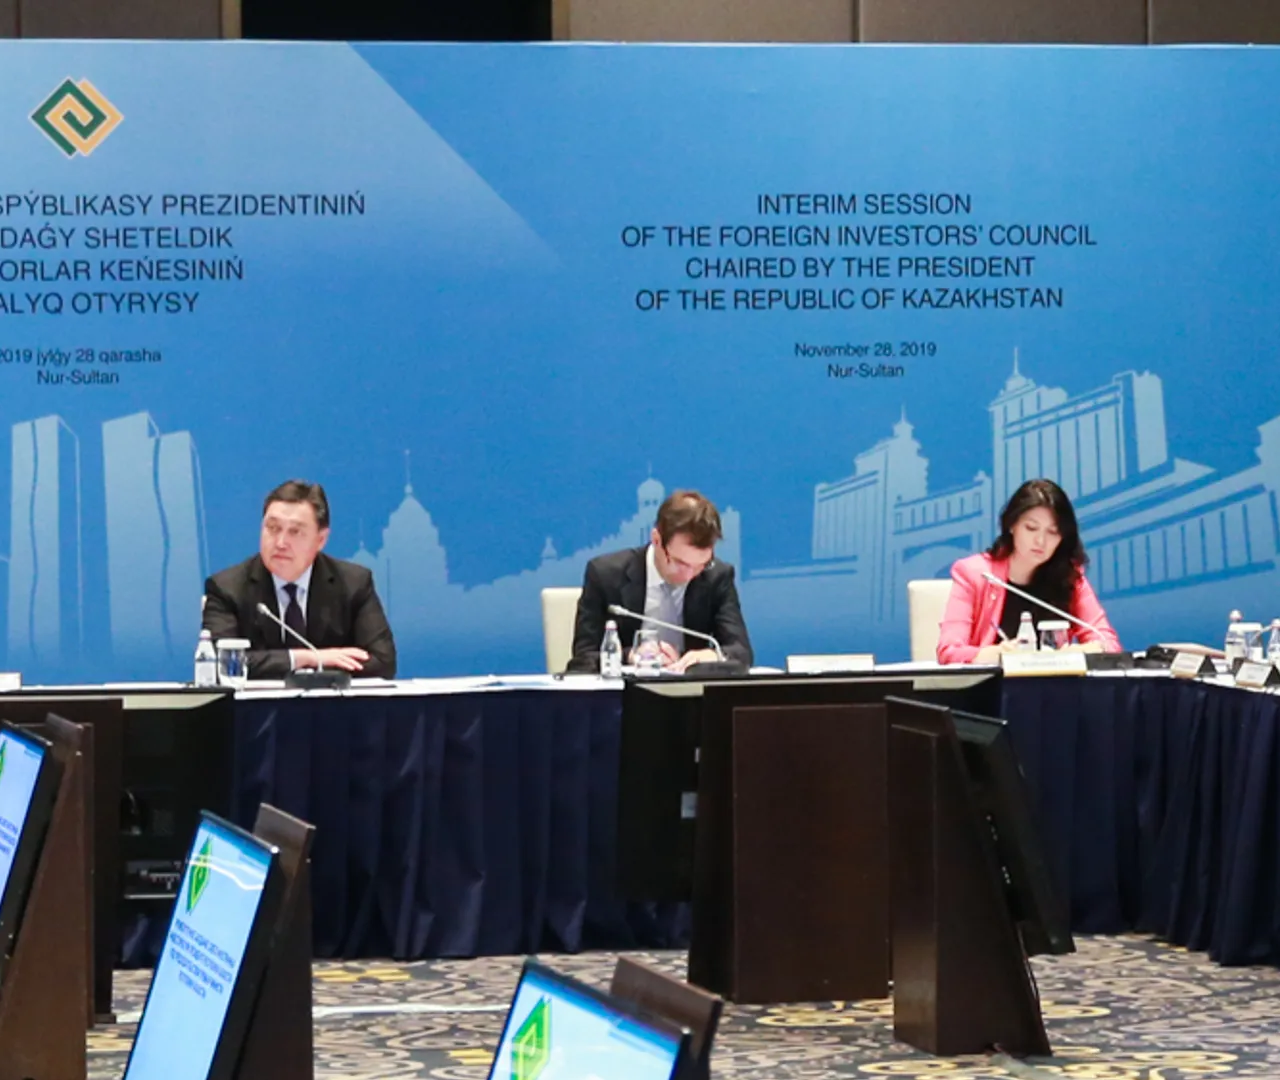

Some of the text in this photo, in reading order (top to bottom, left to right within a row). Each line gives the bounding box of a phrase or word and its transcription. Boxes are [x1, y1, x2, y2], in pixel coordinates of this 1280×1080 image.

[162, 190, 364, 216] PREZIDENTINIŃ
[758, 193, 970, 215] INTERIM SESSION
[85, 227, 232, 249] SHETELDIK
[621, 226, 656, 247] OF
[662, 226, 711, 247] THE
[720, 225, 829, 247] FOREIGN
[989, 224, 1097, 246] COUNCIL
[101, 256, 242, 281] KEŃESINIŃ
[686, 256, 1035, 279] CHAIRED BY THE PRESIDENT
[72, 291, 199, 314] OTYRYSY
[636, 288, 1062, 311] OF THE REPUBLIC OF KAZAKHSTAN
[76, 349, 95, 363] 28
[99, 348, 161, 364] qarasha
[794, 343, 870, 358] November
[900, 342, 937, 357] 2019
[37, 369, 119, 385] Nur-Sultan
[828, 363, 904, 378] Nur-Sultan
